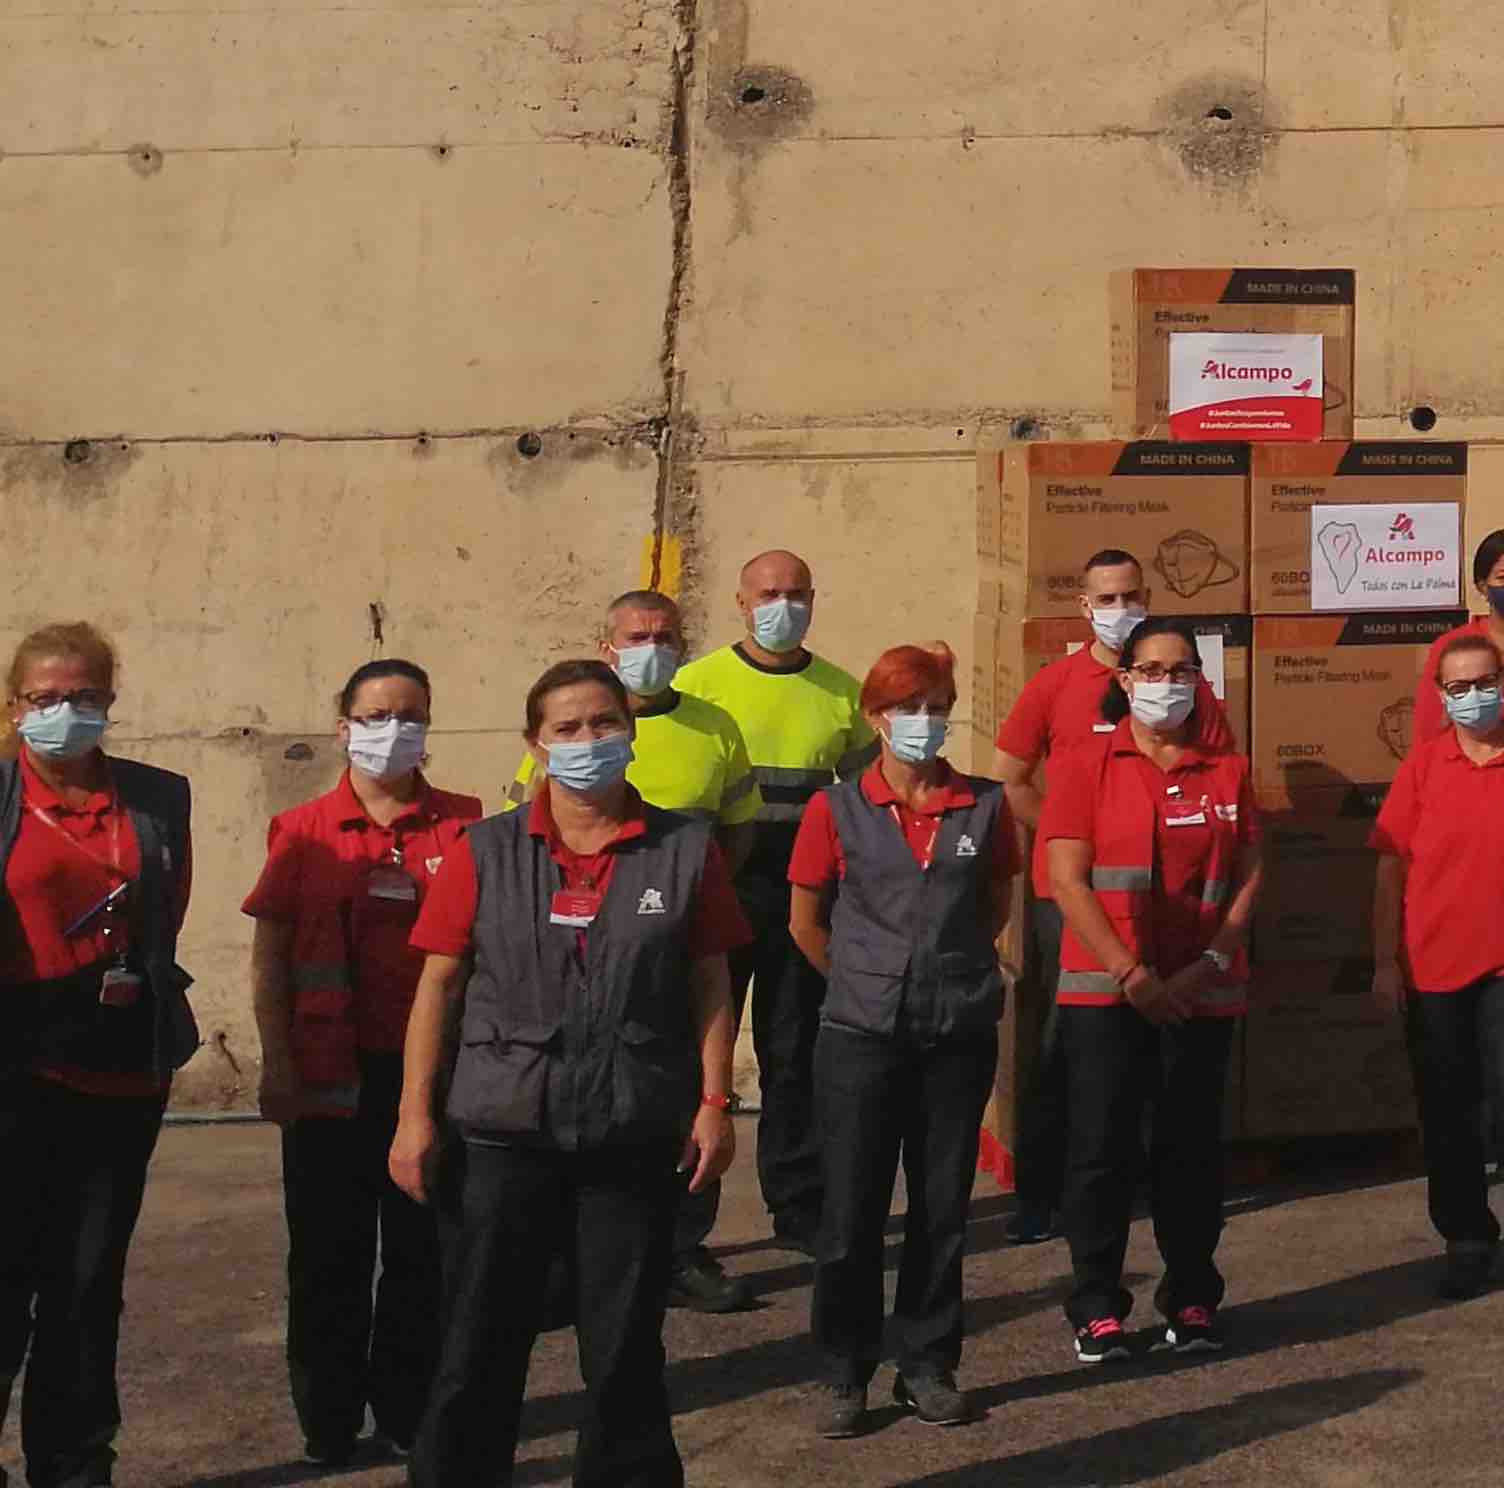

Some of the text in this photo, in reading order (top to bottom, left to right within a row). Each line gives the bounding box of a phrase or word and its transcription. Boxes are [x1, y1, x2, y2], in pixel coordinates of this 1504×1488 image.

[1201, 360, 1293, 382] Alcampo
[1140, 455, 1235, 465] MADE IN CHINA
[1363, 456, 1453, 465] MADE IN CHINA
[1046, 485, 1102, 497] Effective
[1272, 485, 1326, 496] Effective
[1365, 547, 1445, 566] Alcampo
[1361, 578, 1456, 592] Todos con La Palma
[1274, 656, 1328, 667] Effective
